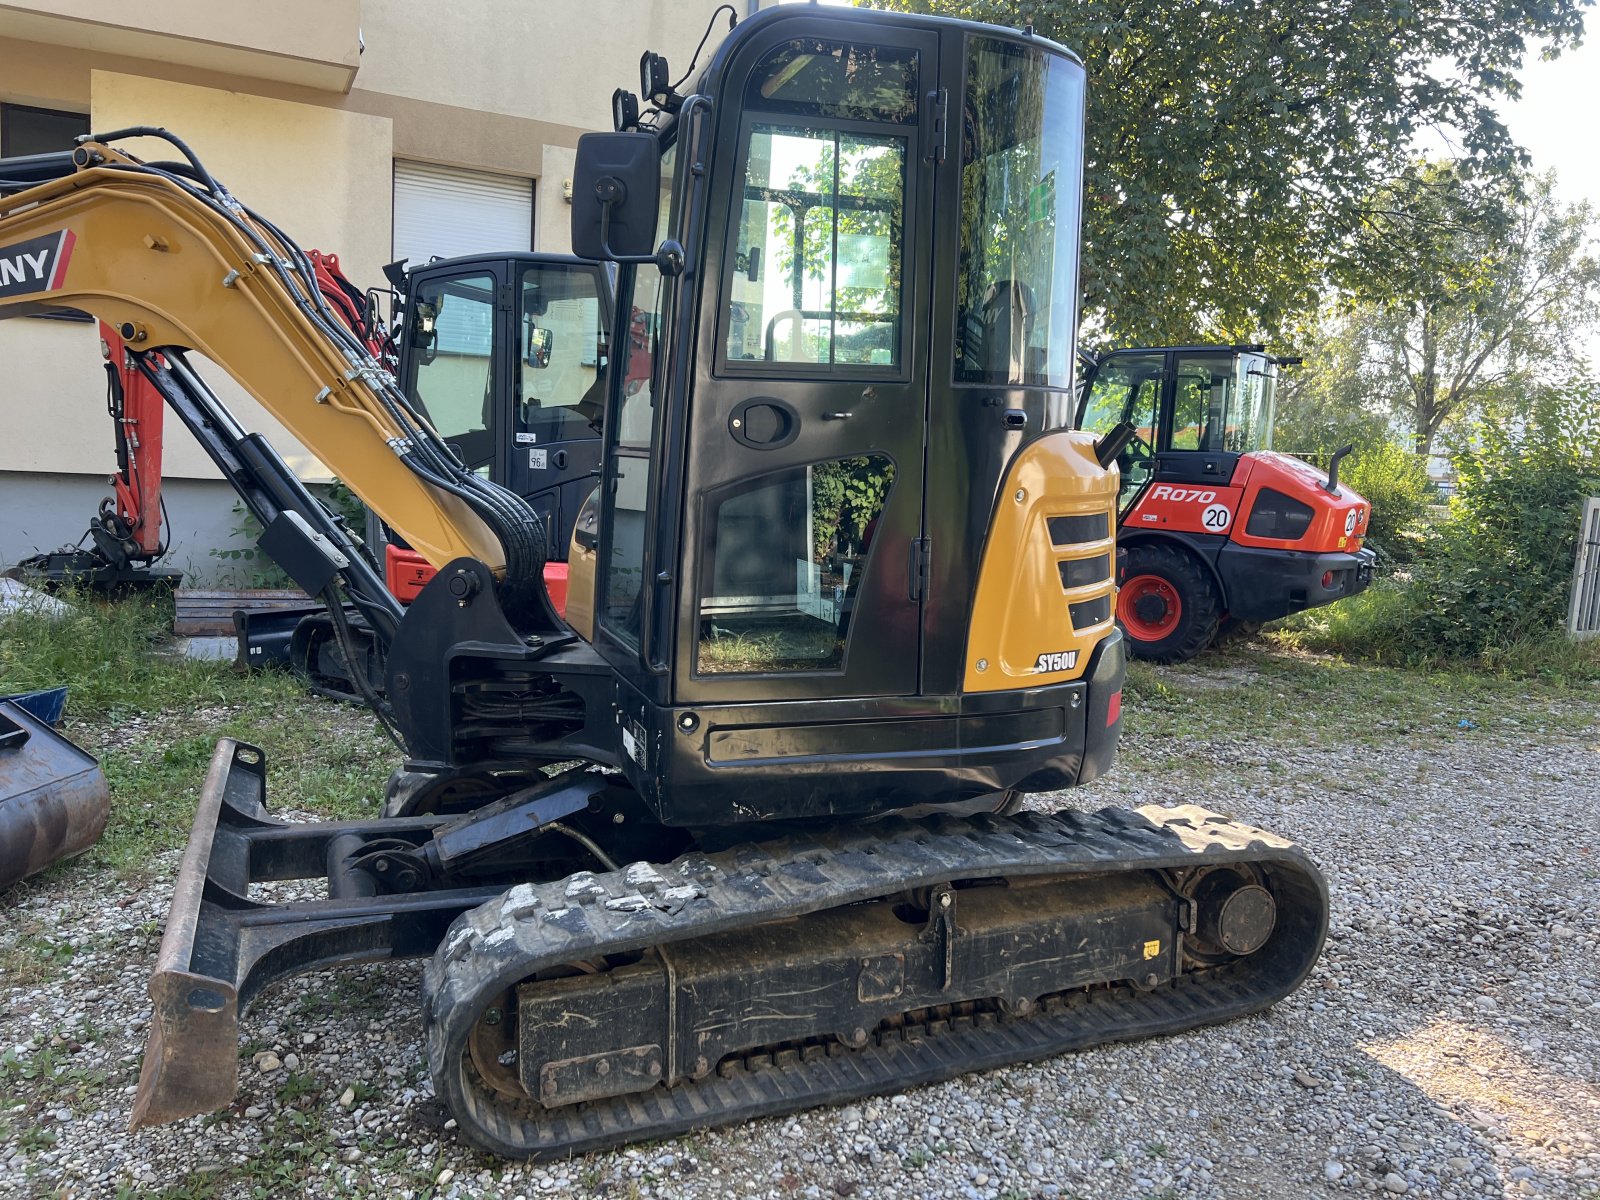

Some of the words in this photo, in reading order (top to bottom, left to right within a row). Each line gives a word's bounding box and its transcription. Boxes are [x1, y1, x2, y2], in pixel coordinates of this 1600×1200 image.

[0, 249, 48, 286] NY
[1206, 509, 1228, 527] 20
[1346, 514, 1356, 531] 20
[1038, 651, 1076, 673] SY50U
